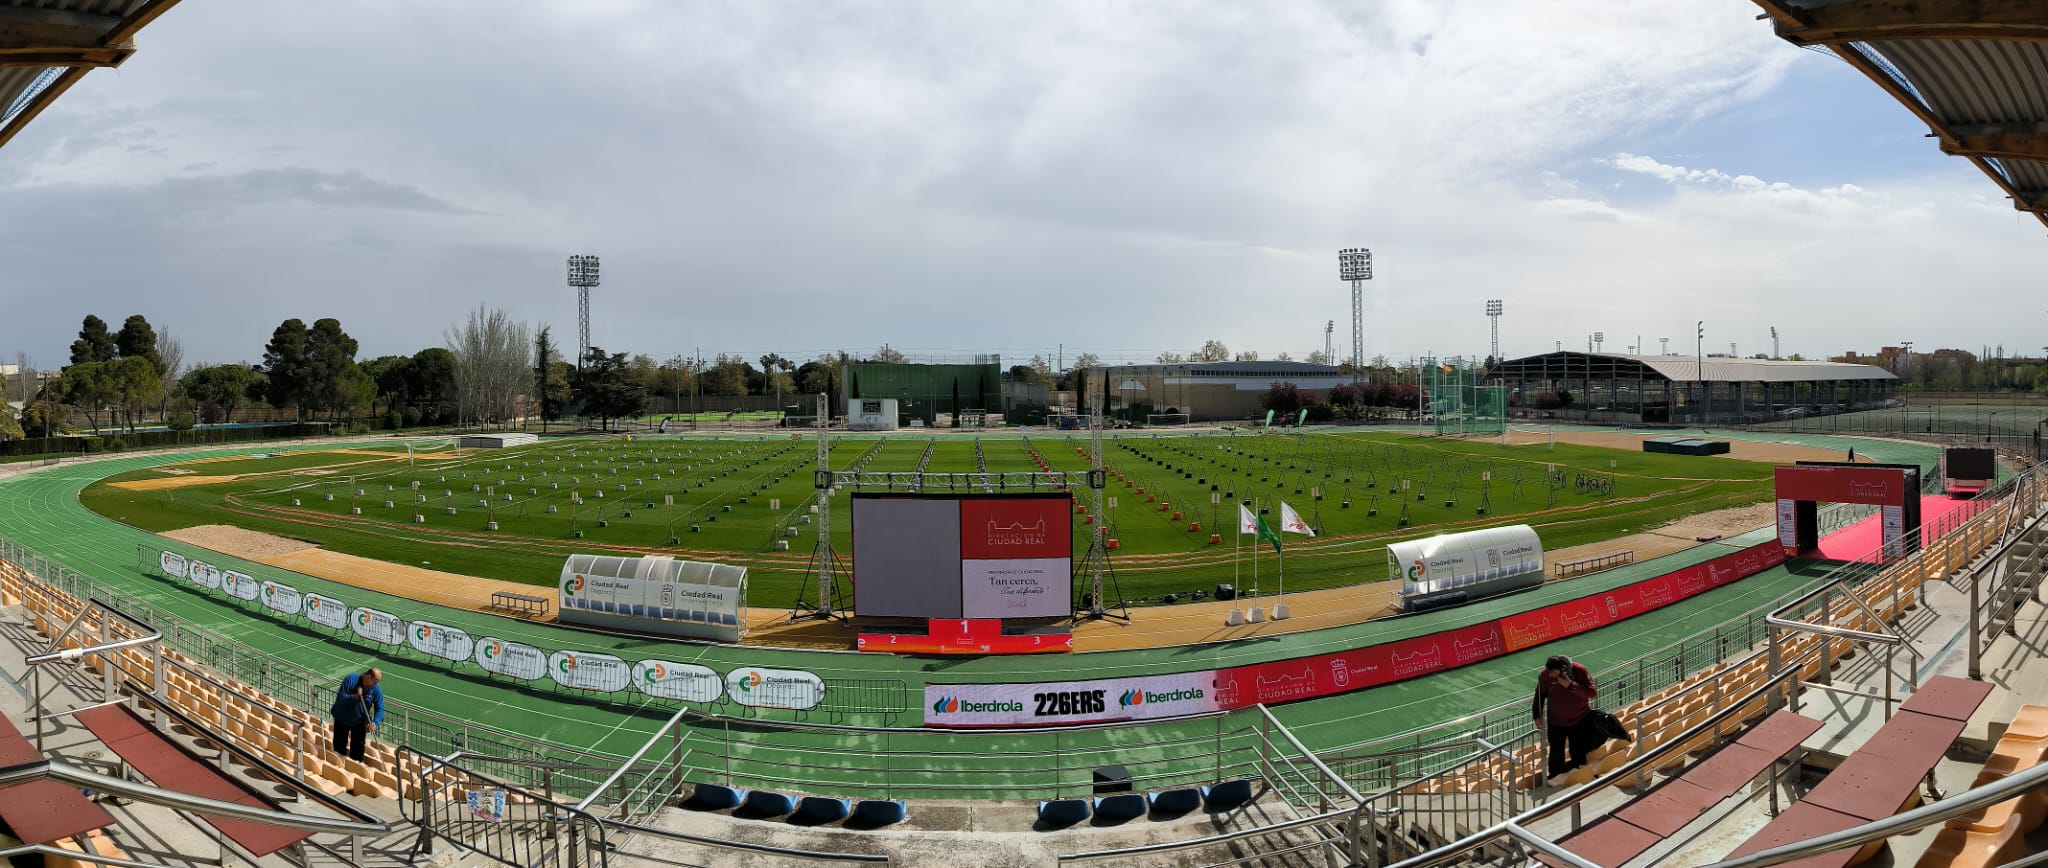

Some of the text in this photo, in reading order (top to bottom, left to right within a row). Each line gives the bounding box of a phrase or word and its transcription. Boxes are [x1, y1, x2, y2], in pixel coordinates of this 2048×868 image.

[590, 580, 630, 590] Ciudad Real
[988, 577, 1008, 585] Tan
[681, 590, 723, 600] Ciudad Real
[960, 620, 969, 633] 1
[890, 635, 897, 644] 2
[1034, 636, 1041, 645] 3
[669, 669, 693, 678] Ciudad
[1394, 664, 1424, 676] CIUDAD
[766, 676, 792, 684] Ciudad
[1145, 687, 1204, 704] Iberdrola
[1258, 685, 1317, 700] CIUDAD REAL
[960, 699, 1023, 713] Iberdrola
[1033, 690, 1106, 716] 226ERS
